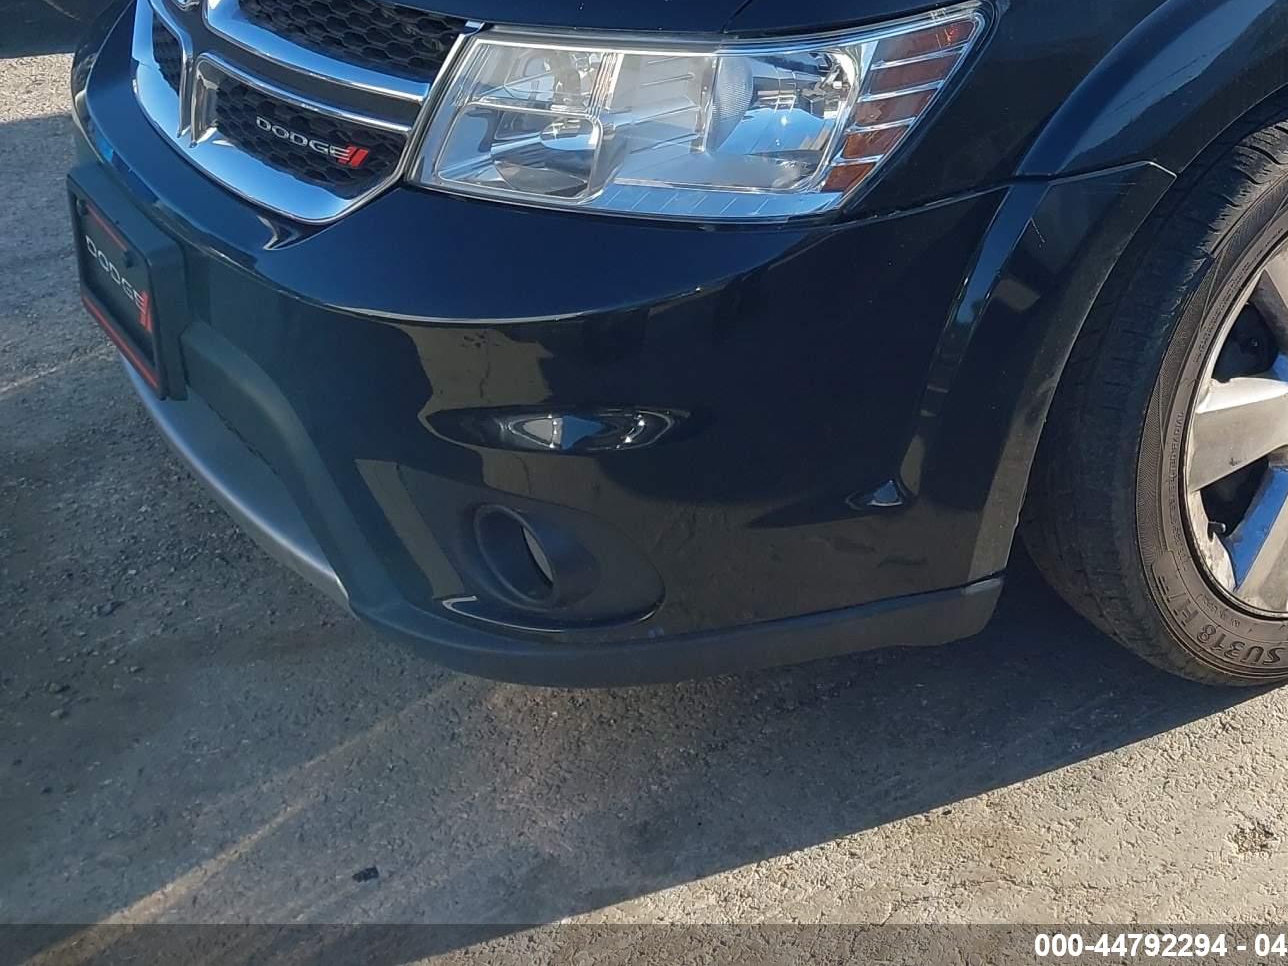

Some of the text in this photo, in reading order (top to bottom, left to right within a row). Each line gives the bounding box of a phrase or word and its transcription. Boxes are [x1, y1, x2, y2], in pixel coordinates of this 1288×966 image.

[256, 116, 350, 161] DODGE
[85, 235, 146, 315] DODGE
[1197, 624, 1286, 666] SU318
